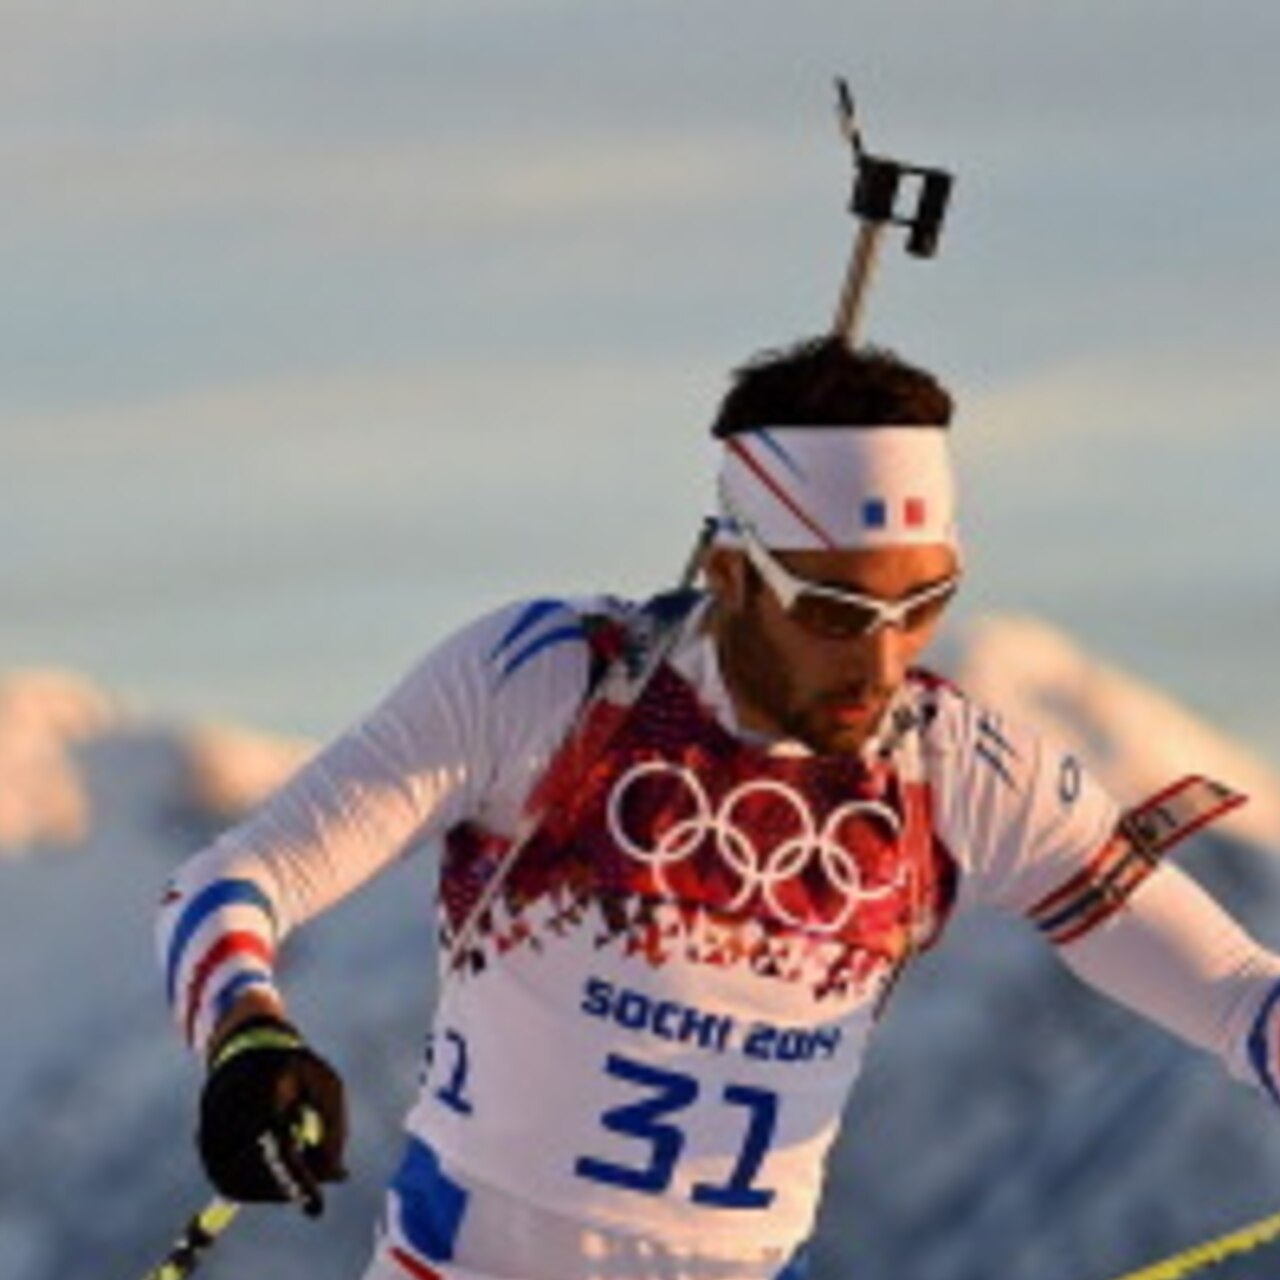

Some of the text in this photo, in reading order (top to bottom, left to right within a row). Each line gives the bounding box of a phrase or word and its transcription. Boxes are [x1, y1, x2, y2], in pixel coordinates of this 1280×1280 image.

[581, 976, 841, 1061] SOCHI 2014
[574, 1053, 778, 1209] 31
